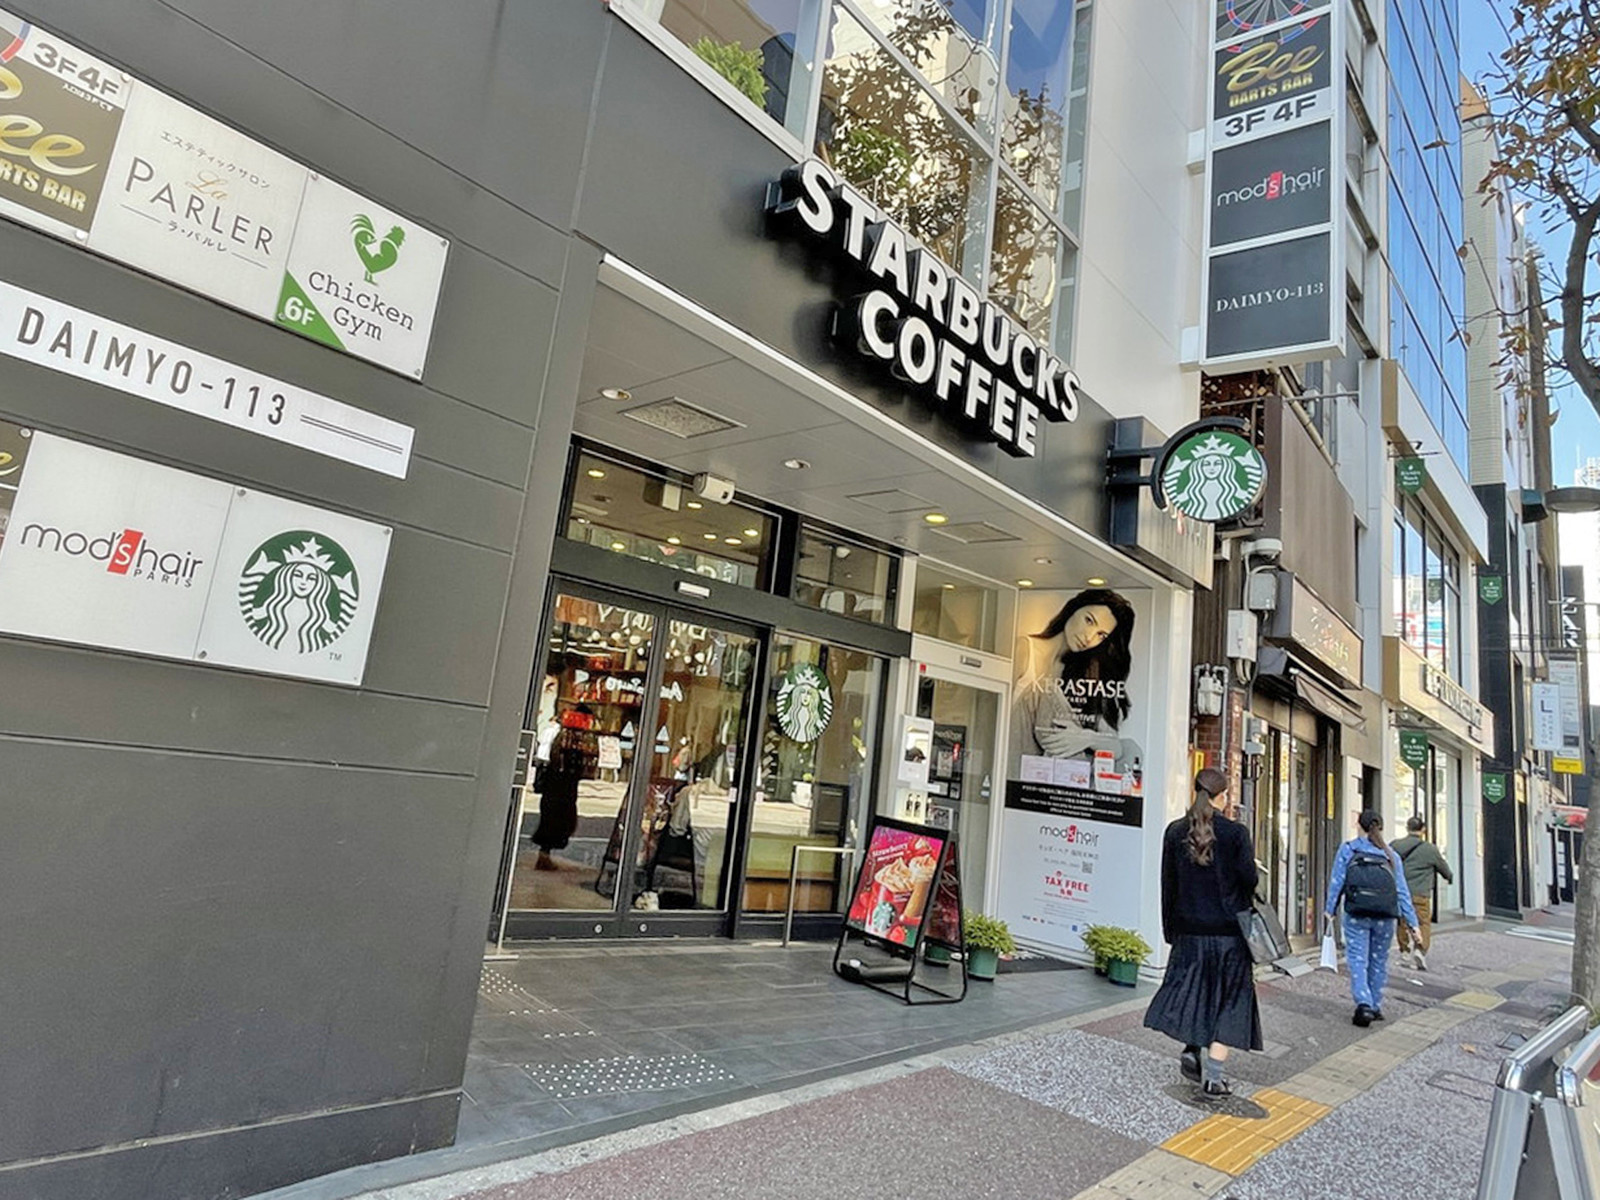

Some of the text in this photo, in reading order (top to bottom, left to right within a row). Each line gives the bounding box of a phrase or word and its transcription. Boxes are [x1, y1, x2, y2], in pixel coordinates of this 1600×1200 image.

[1218, 41, 1325, 92] Bee
[1228, 72, 1313, 108] DARTS BAR
[0, 65, 98, 176] ee
[1225, 94, 1317, 138] 3F 4F
[0, 157, 88, 212] RTS BAR
[160, 130, 271, 189] エステティックサロン
[125, 156, 273, 255] PARLER
[283, 295, 316, 327] 6F
[308, 270, 415, 332] Chicken
[796, 157, 1081, 423] STARBUCKS
[1216, 282, 1324, 312] DAIMYO-113
[333, 307, 384, 342] Gym
[17, 307, 287, 427] DAIMYO-113
[861, 289, 1039, 457] COFFEE
[133, 569, 194, 589] PARIS
[1044, 875, 1062, 887] TAX
[1065, 879, 1090, 893] FREE
